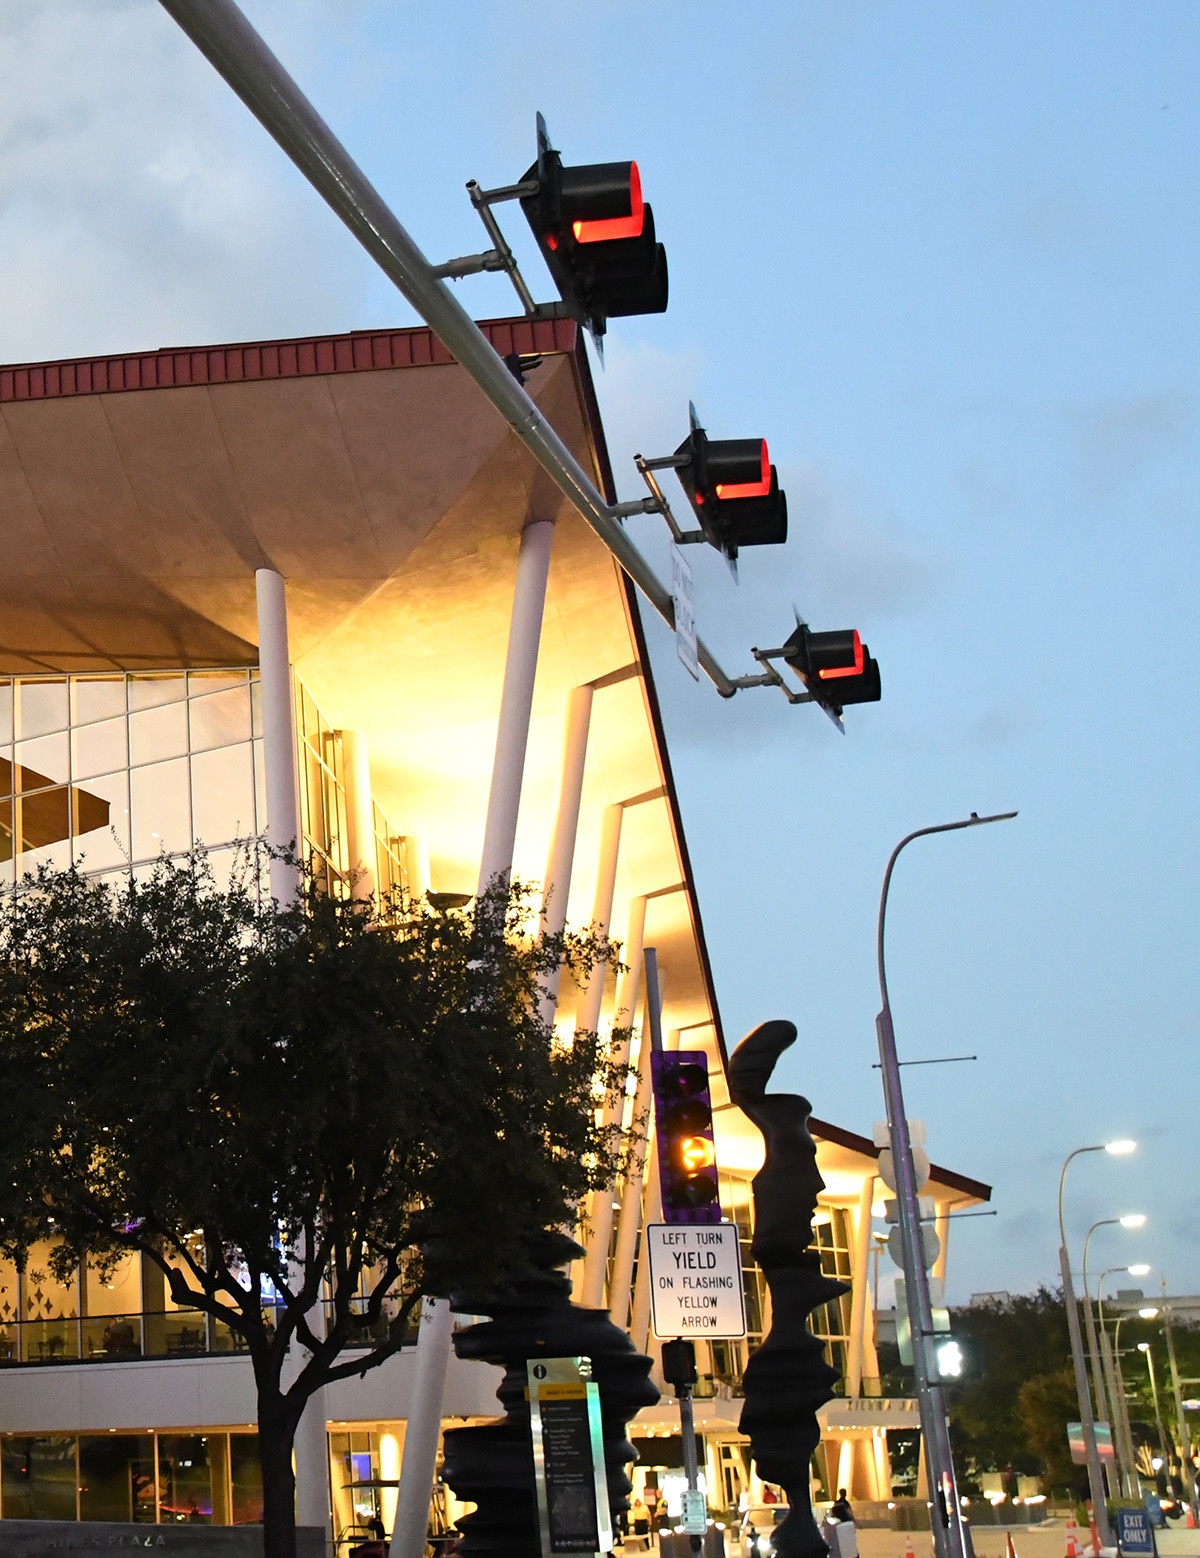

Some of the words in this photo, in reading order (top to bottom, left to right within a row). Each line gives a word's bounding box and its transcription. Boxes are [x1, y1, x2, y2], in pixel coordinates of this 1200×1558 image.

[662, 1232, 687, 1245] LEFT
[696, 1232, 723, 1245] TURN
[672, 1251, 716, 1269] YIELD
[659, 1277, 674, 1289] ON
[682, 1276, 733, 1289] FLASHING
[677, 1296, 718, 1309] YELLOW
[681, 1315, 718, 1328] ARROW
[1123, 1514, 1143, 1528] EXIT
[1123, 1529, 1147, 1543] ONLY
